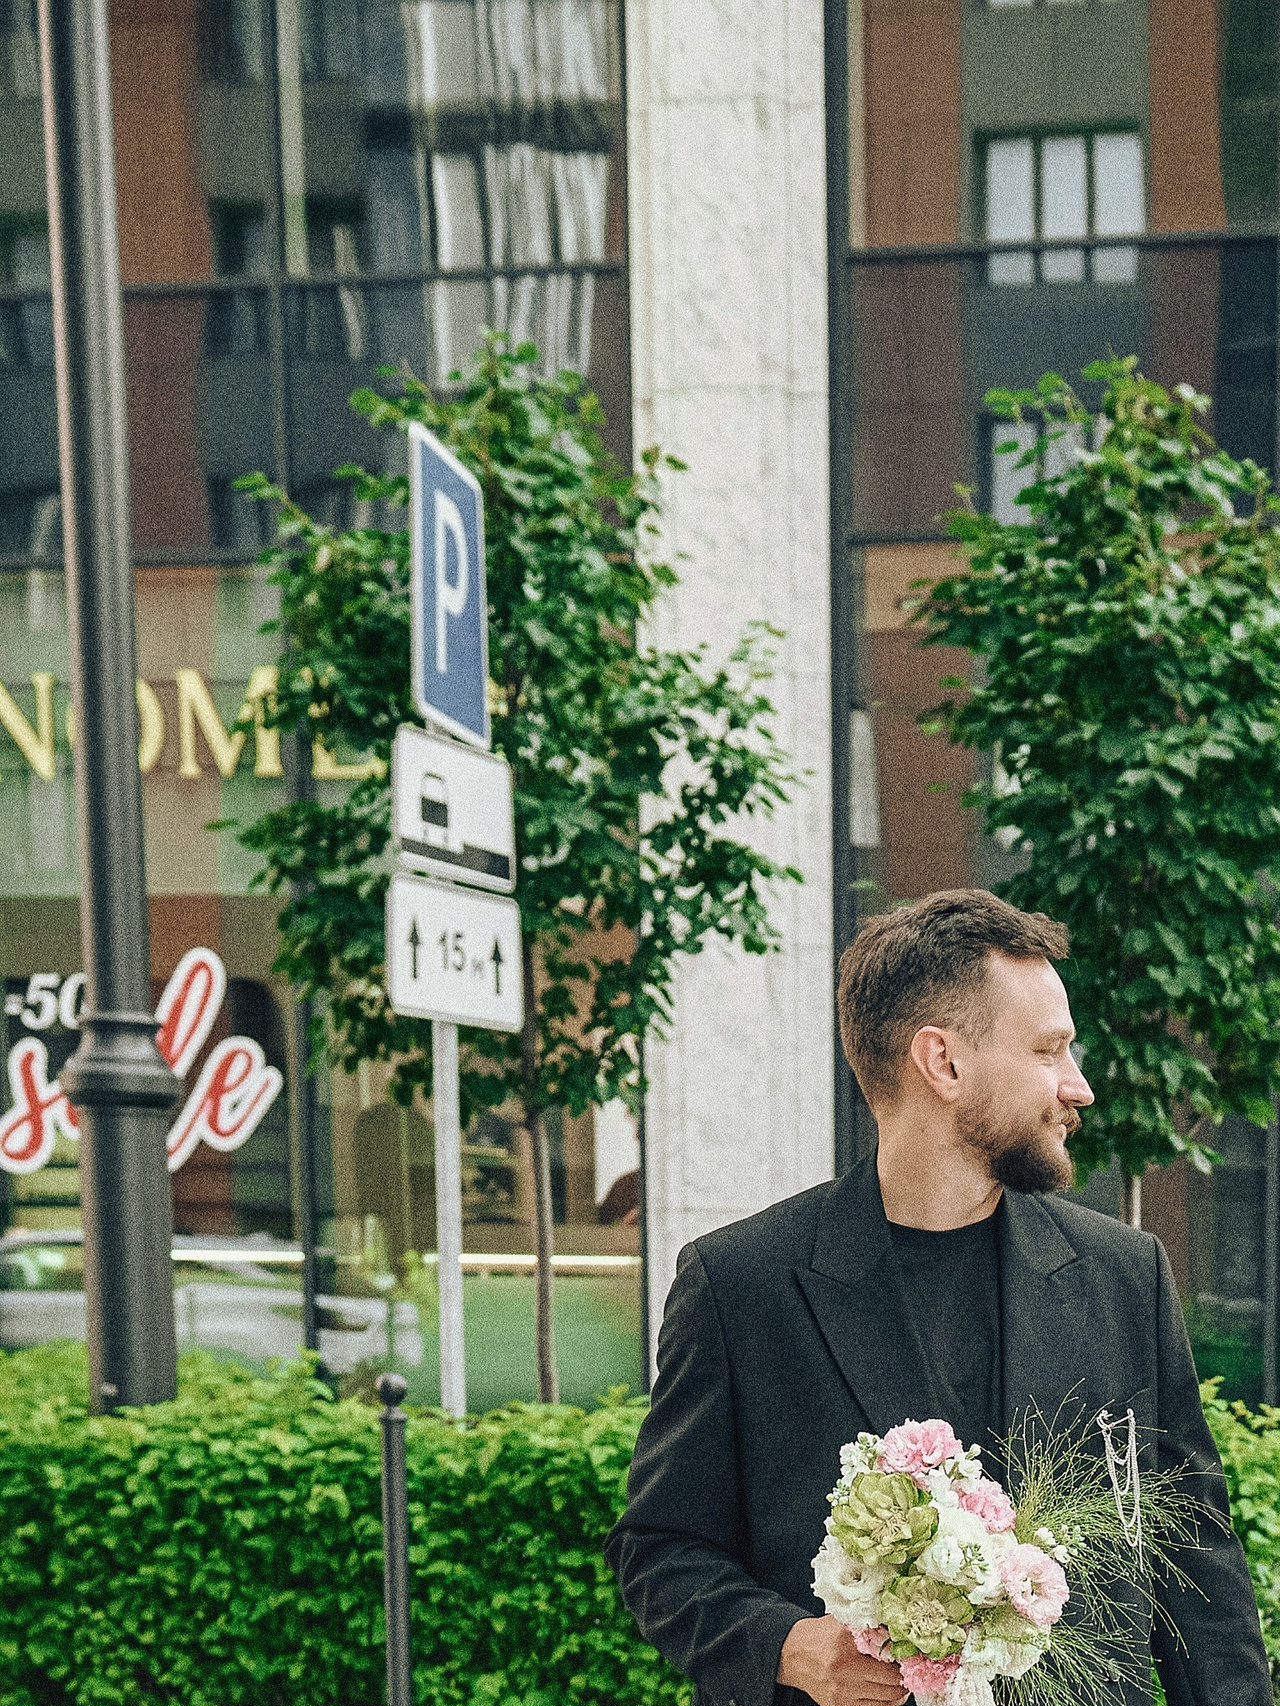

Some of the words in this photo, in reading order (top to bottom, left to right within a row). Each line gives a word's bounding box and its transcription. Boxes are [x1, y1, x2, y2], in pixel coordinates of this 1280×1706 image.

[435, 487, 470, 674] P
[439, 929, 467, 972] 15
[0, 946, 283, 1174] sle
